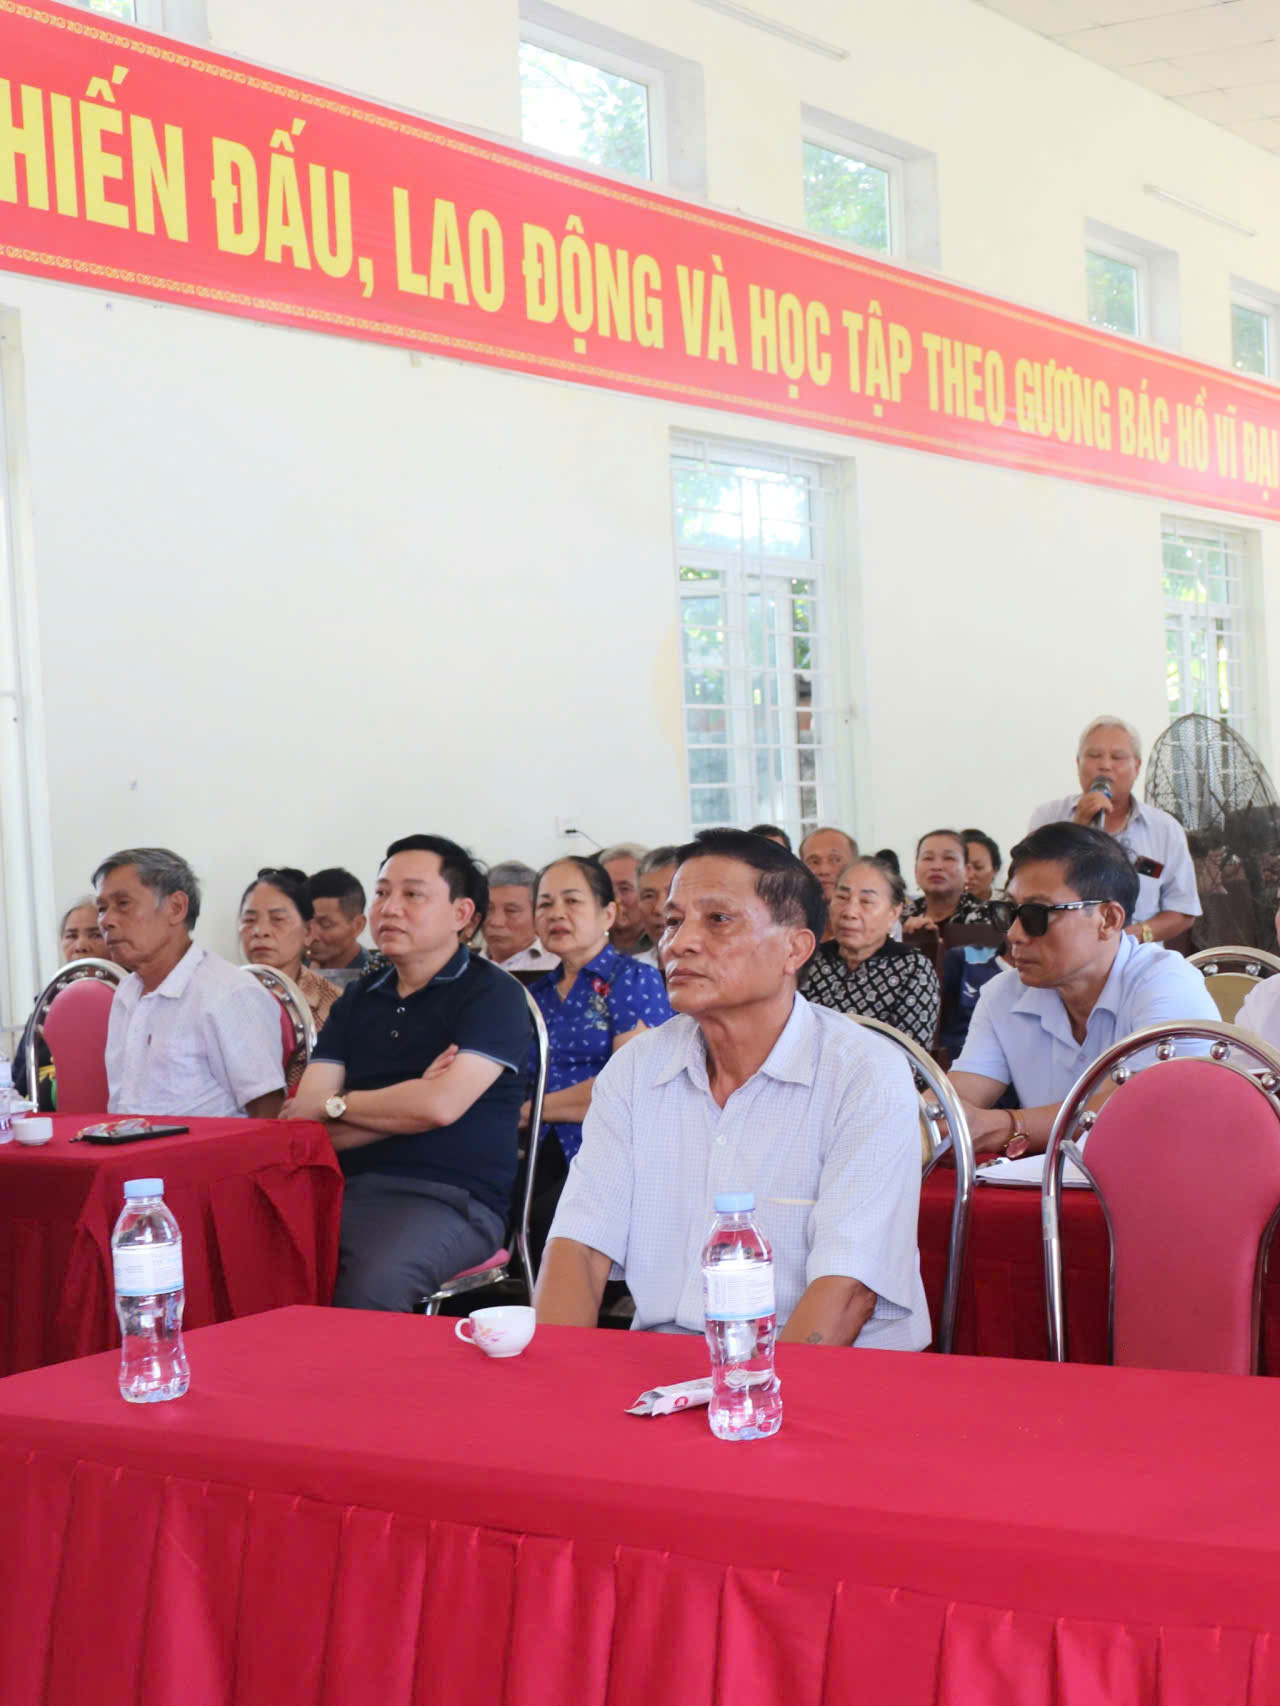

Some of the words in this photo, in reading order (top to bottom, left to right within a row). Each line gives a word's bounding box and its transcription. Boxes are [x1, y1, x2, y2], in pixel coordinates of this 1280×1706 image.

[0, 65, 189, 242] HIẾN
[211, 118, 374, 298] ĐẤU,
[393, 186, 505, 313] LAO
[521, 215, 664, 353] ĐỘNG
[676, 254, 738, 366] VÀ
[749, 284, 831, 399] HỌC
[842, 300, 912, 417] TẬP
[922, 333, 1006, 427] THEO
[1015, 357, 1112, 452] GƯƠNG
[1118, 377, 1170, 464] BÁC
[1176, 386, 1209, 473] HỒ
[1215, 405, 1237, 480] VĨ
[1242, 421, 1279, 501] ĐẠI
